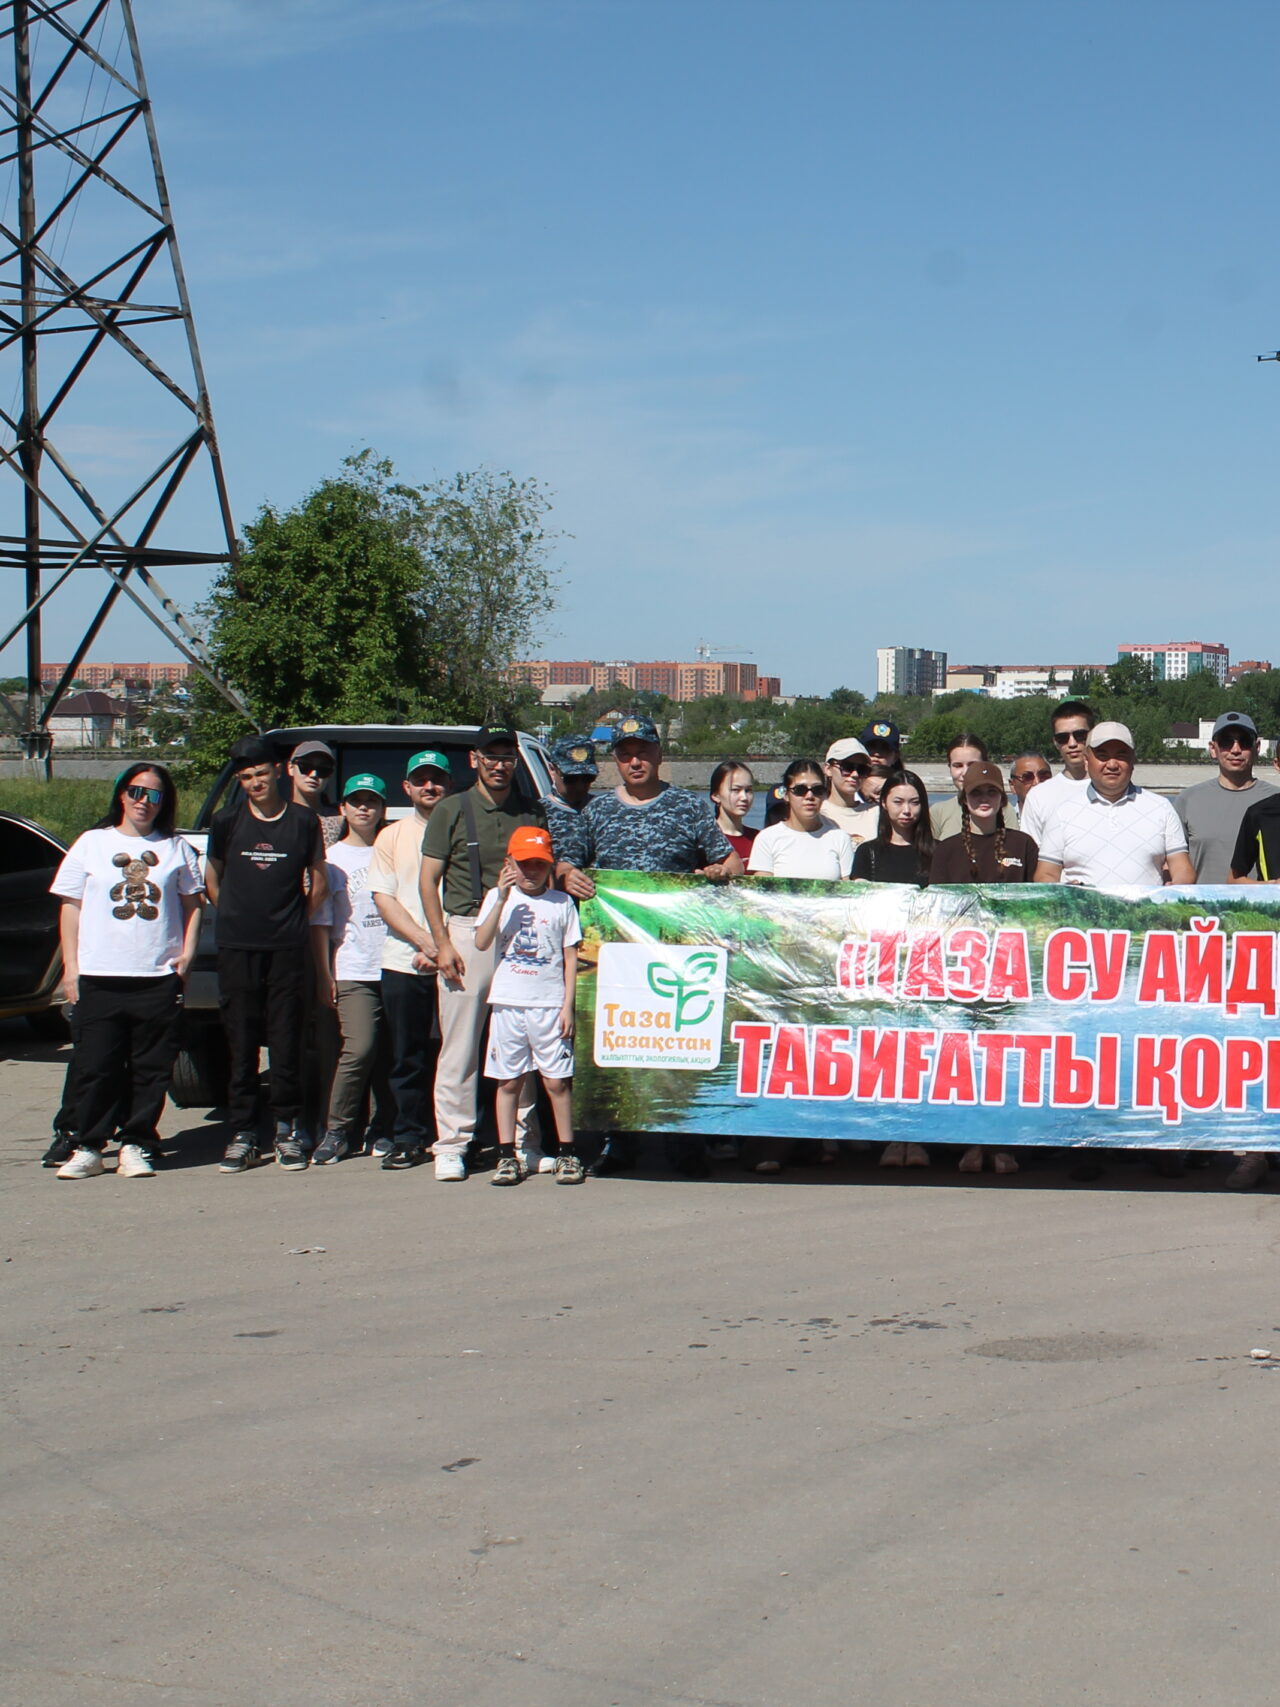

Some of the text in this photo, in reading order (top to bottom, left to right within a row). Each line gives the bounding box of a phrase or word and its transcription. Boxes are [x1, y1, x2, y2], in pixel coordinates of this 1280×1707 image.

[838, 930, 1030, 1000] «ТАЗА
[1046, 929, 1128, 1002] СУ
[603, 1003, 672, 1029] Таза
[602, 1031, 712, 1052] Қазақстан
[734, 1024, 1119, 1106] ТАБИҒАТТЫ
